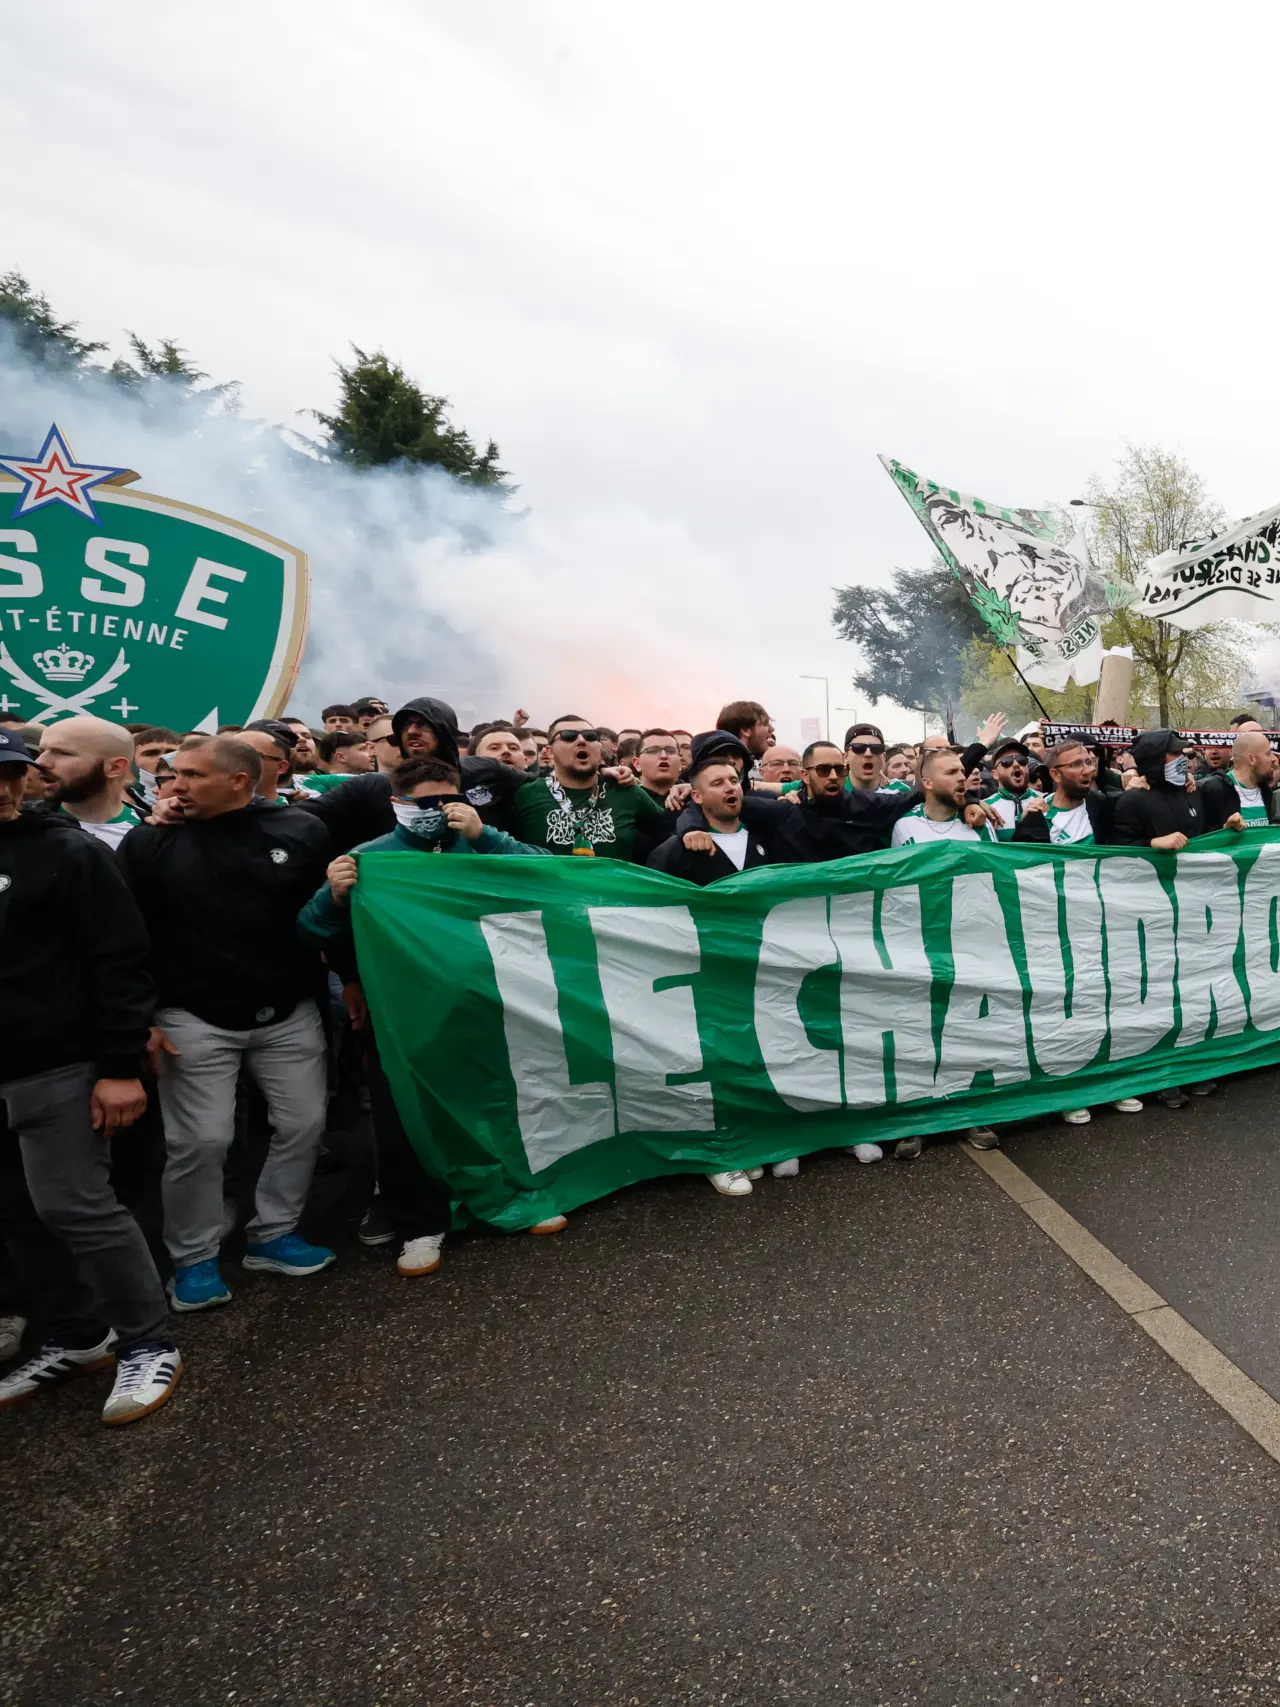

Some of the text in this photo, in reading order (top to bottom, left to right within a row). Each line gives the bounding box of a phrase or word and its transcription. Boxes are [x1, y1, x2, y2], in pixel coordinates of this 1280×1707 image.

[0, 605, 189, 651] T-ÉTIENNE
[1043, 725, 1133, 736] DEPOURVUS
[479, 905, 715, 1175] LE
